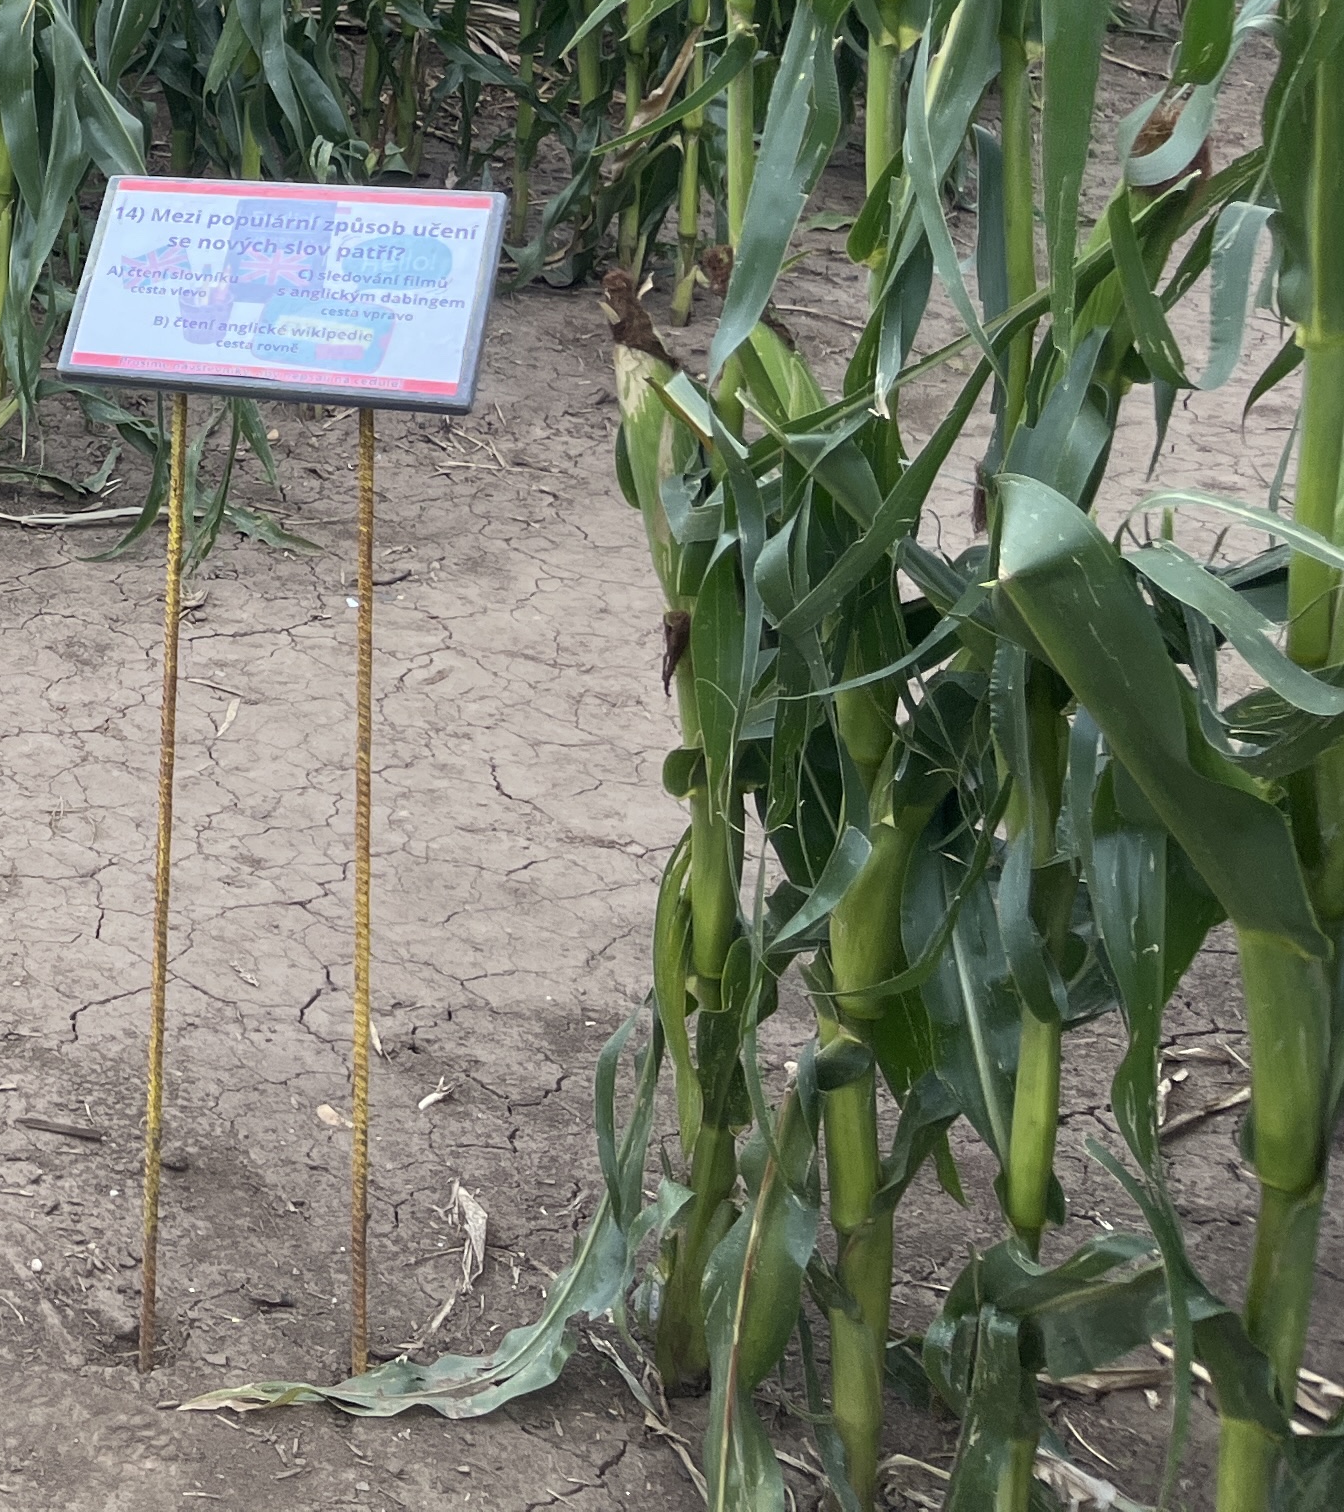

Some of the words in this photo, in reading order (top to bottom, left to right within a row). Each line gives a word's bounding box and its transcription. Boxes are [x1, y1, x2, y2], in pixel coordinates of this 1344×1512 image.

[115, 206, 145, 223] 14)
[151, 208, 202, 224] Mezi
[207, 212, 321, 230] populární
[323, 217, 405, 236] způsob
[413, 222, 480, 239] učení
[167, 236, 191, 249] se
[198, 236, 277, 256] nových
[284, 240, 331, 256] slov
[336, 245, 406, 261] patří?
[106, 265, 123, 278] A)
[127, 266, 169, 279] čtení
[170, 268, 239, 284] slovníku
[298, 269, 313, 282] C)
[318, 270, 400, 286] sledování
[403, 275, 449, 288] filmů
[130, 285, 166, 296] cesta
[170, 287, 207, 298] vlevo
[277, 288, 285, 297] s
[290, 288, 376, 303] anglickým
[380, 293, 465, 309] dabingem
[320, 307, 358, 318] cesta
[363, 310, 414, 322] vpravo
[153, 315, 169, 328] B)
[173, 316, 215, 330] čtení
[217, 321, 287, 336] anglické
[292, 326, 373, 342] wikipedie
[216, 339, 252, 350] cesta
[257, 341, 298, 353] rovně
